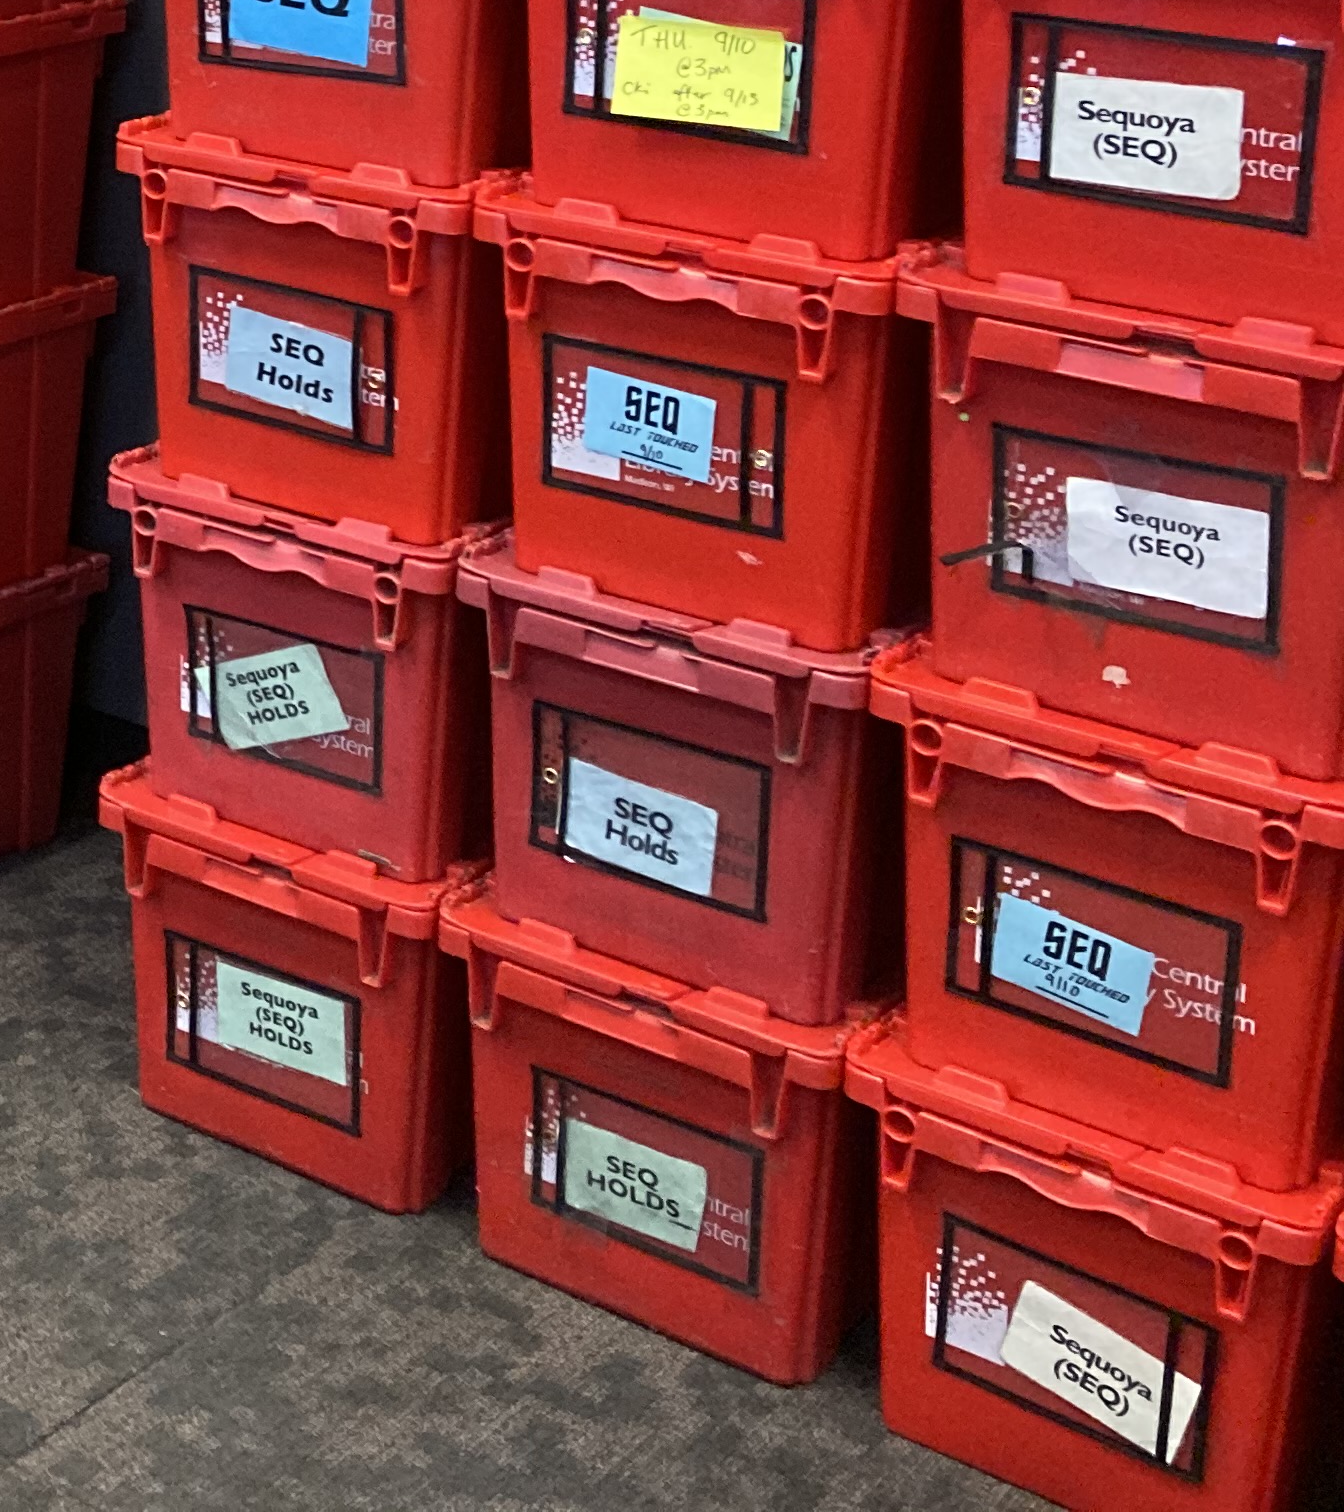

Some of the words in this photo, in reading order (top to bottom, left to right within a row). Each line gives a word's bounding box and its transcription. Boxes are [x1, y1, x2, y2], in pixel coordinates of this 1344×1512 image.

[713, 30, 756, 56] 9/10
[1077, 99, 1196, 136] Sequoya
[1093, 132, 1178, 169] (SEQ)
[269, 332, 326, 367] SEQ
[256, 361, 334, 404] Holds
[624, 385, 680, 435] SEQ
[646, 431, 699, 453] TOUCHED
[1114, 505, 1222, 543] Sequoya
[1128, 533, 1205, 569] (SEQ)
[225, 661, 301, 687] Sequoya
[246, 682, 295, 708] (SEQ)
[246, 699, 310, 726] HOLDS
[613, 796, 673, 840] SEQ
[604, 818, 680, 866] Holds
[1043, 920, 1112, 982] SEQ
[240, 981, 320, 1020] Sequoya
[1068, 972, 1131, 1004] TOUCHED
[249, 1021, 314, 1055] HOLDS
[255, 1005, 305, 1037] (SEQ)
[606, 1154, 659, 1192] SEQ
[586, 1169, 681, 1219] HOLDS
[1050, 1323, 1154, 1403] Sequoya
[1053, 1357, 1131, 1418] (SEQ)
